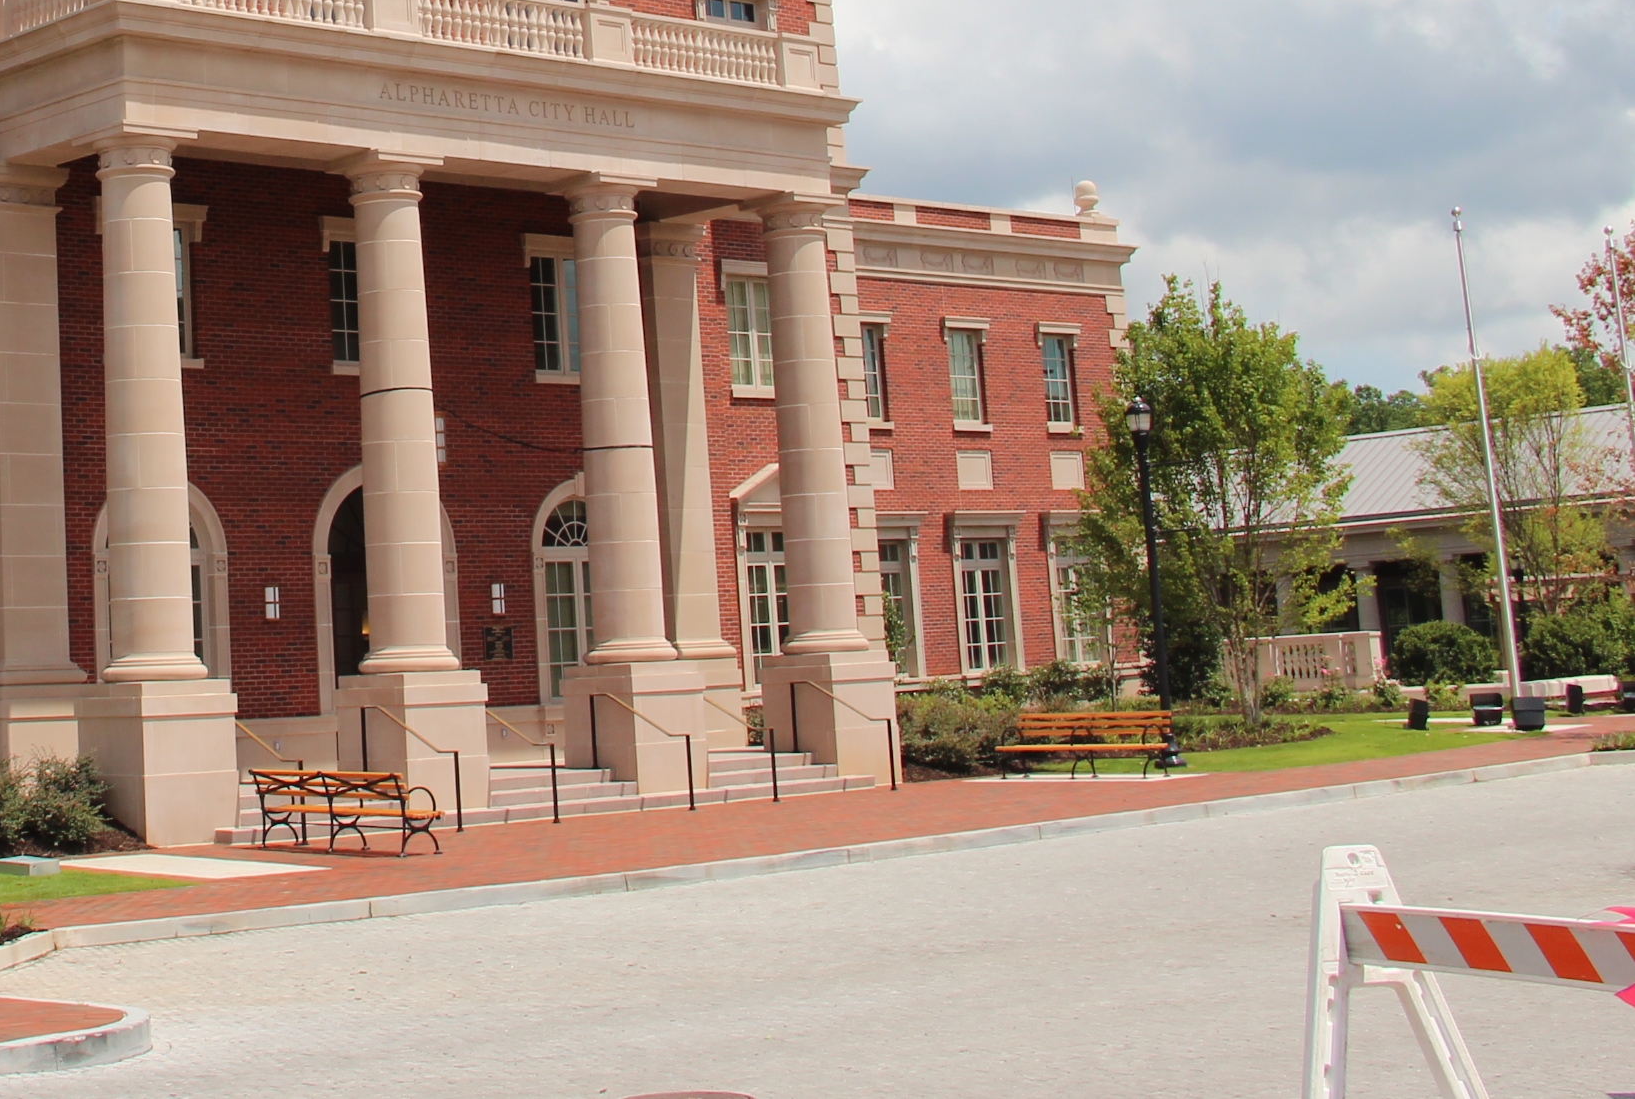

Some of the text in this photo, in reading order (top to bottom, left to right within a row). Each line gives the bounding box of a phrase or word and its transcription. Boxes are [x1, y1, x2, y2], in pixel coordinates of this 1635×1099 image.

[379, 83, 635, 129] ALPHARETTA CITY HALL
